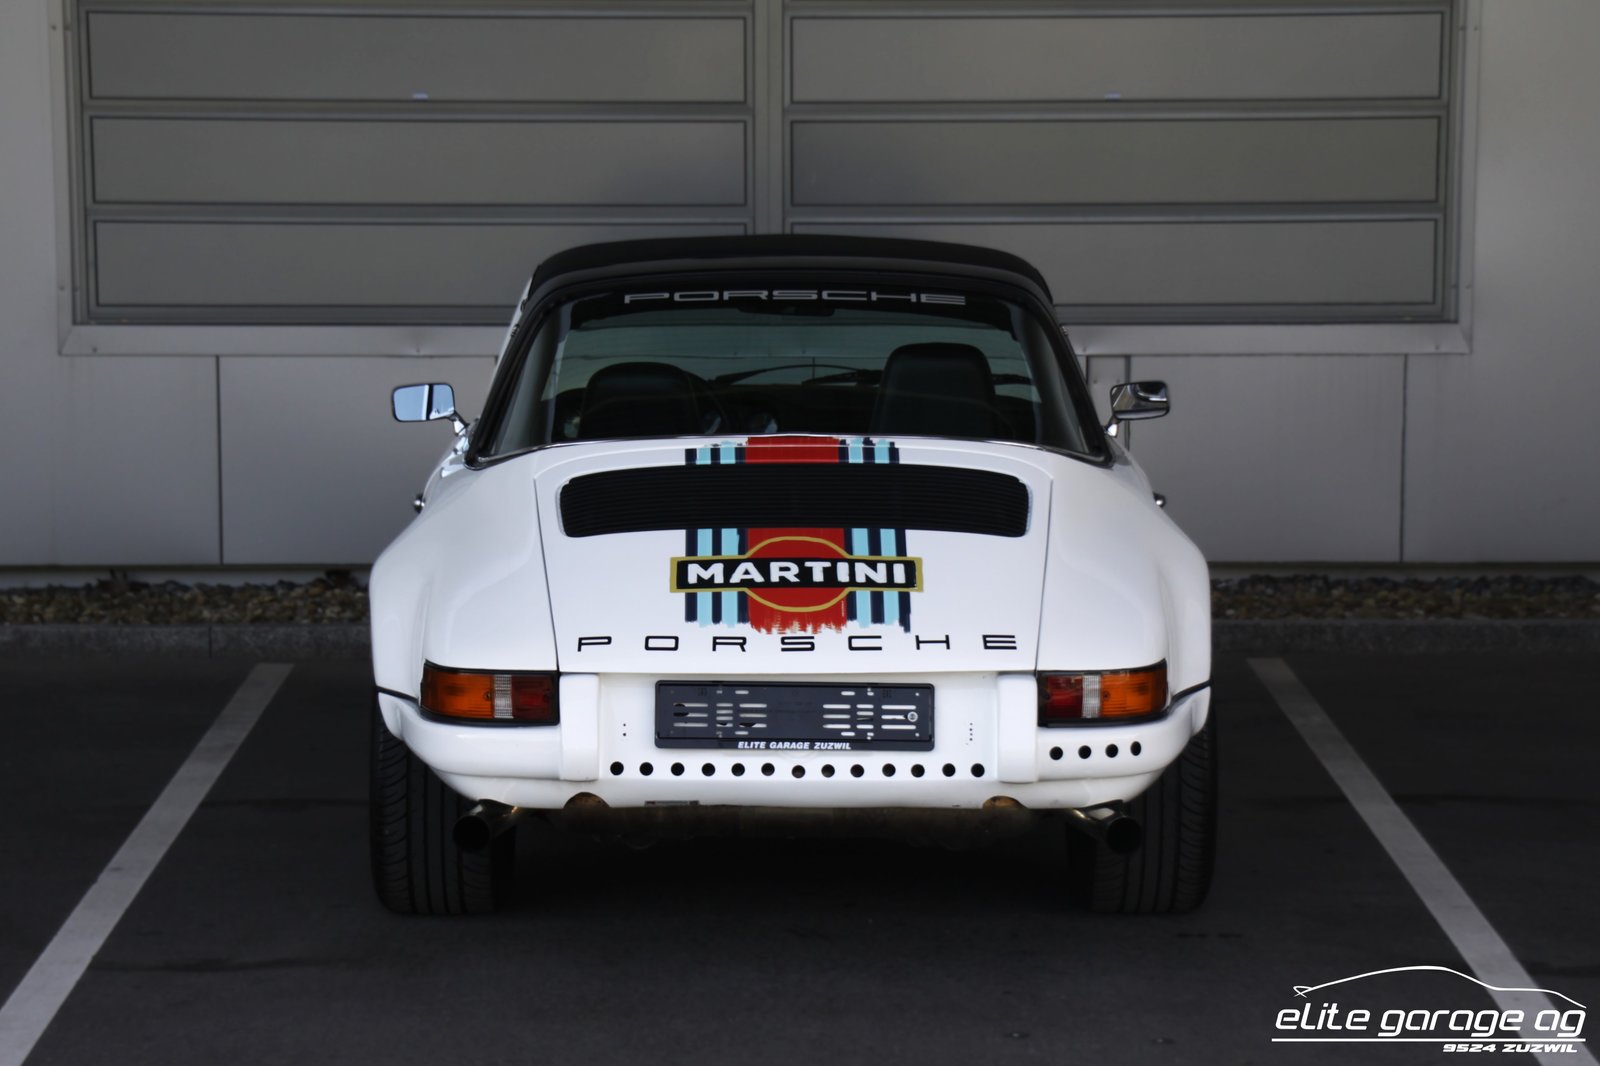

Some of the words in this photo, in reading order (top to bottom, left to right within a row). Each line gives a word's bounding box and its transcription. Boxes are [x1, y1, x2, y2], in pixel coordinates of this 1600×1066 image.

[624, 290, 966, 305] PORSCHE
[687, 561, 907, 585] MARTINI
[578, 635, 1018, 652] PORSCHE
[738, 741, 767, 749] ELITE
[769, 741, 810, 750] GARAGE
[813, 742, 852, 750] ZUZWIL
